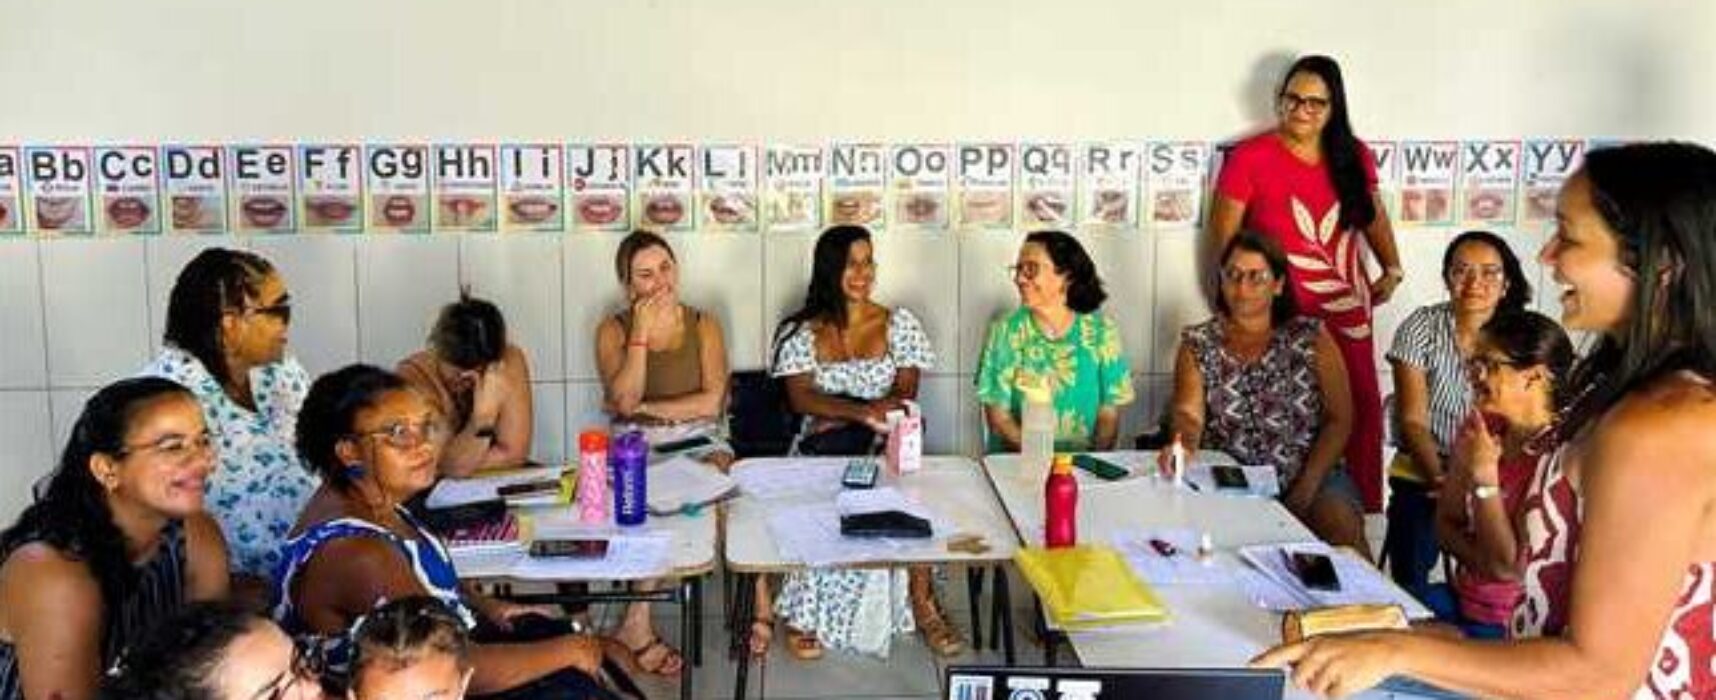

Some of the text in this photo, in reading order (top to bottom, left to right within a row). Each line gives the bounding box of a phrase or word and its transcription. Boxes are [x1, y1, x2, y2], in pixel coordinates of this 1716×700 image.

[32, 151, 84, 181] Bb
[101, 151, 153, 180] Cc
[168, 151, 220, 179] Dd
[238, 150, 287, 179] Ee
[372, 148, 422, 178] Gg
[438, 147, 489, 177] Hh
[638, 149, 687, 177] Kk
[831, 149, 880, 176] Nn
[896, 148, 945, 176] Oo
[961, 148, 1008, 175] Pp
[1024, 148, 1070, 174] Qq
[1152, 145, 1200, 174] Ss
[1405, 148, 1457, 172] Ww
[1467, 145, 1512, 172] Xx
[1530, 143, 1578, 172] Yy
